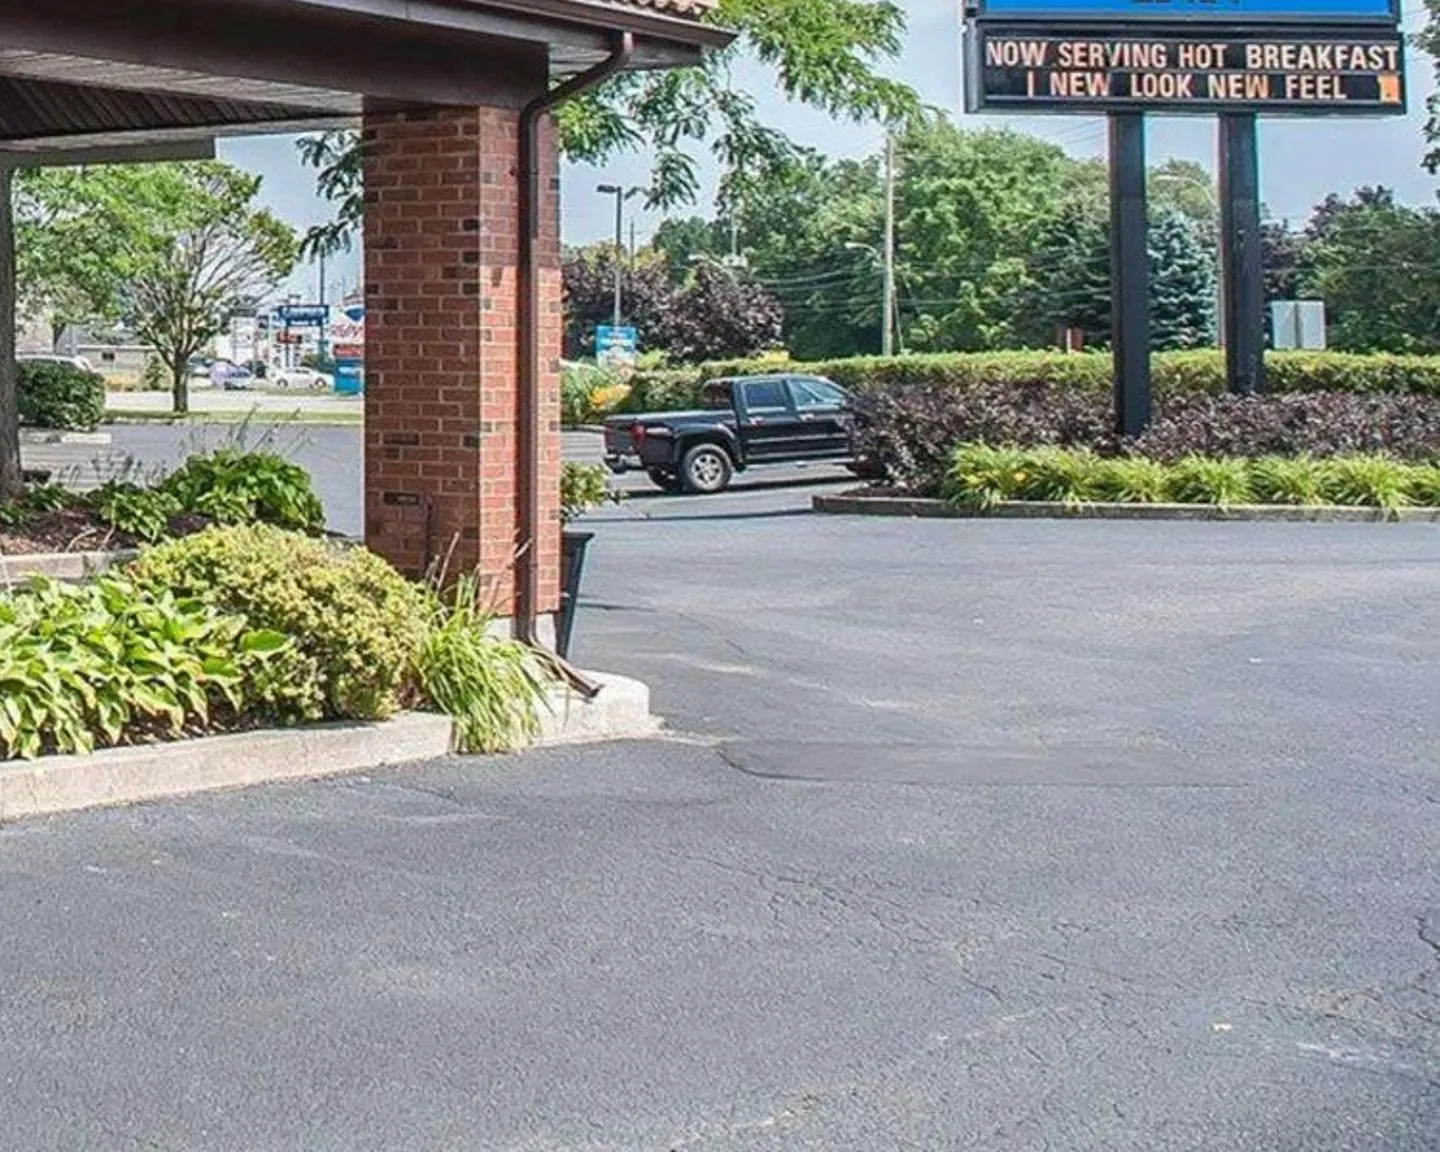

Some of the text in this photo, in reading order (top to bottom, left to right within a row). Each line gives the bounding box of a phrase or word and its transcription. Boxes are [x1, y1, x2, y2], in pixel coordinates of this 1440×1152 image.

[985, 41, 1399, 71] NOW SERVING HOT BREAKFAST
[1050, 72, 1110, 97] NEW
[1130, 73, 1192, 98] LOOK
[1208, 74, 1270, 99] NEW
[1285, 75, 1346, 99] FEEL
